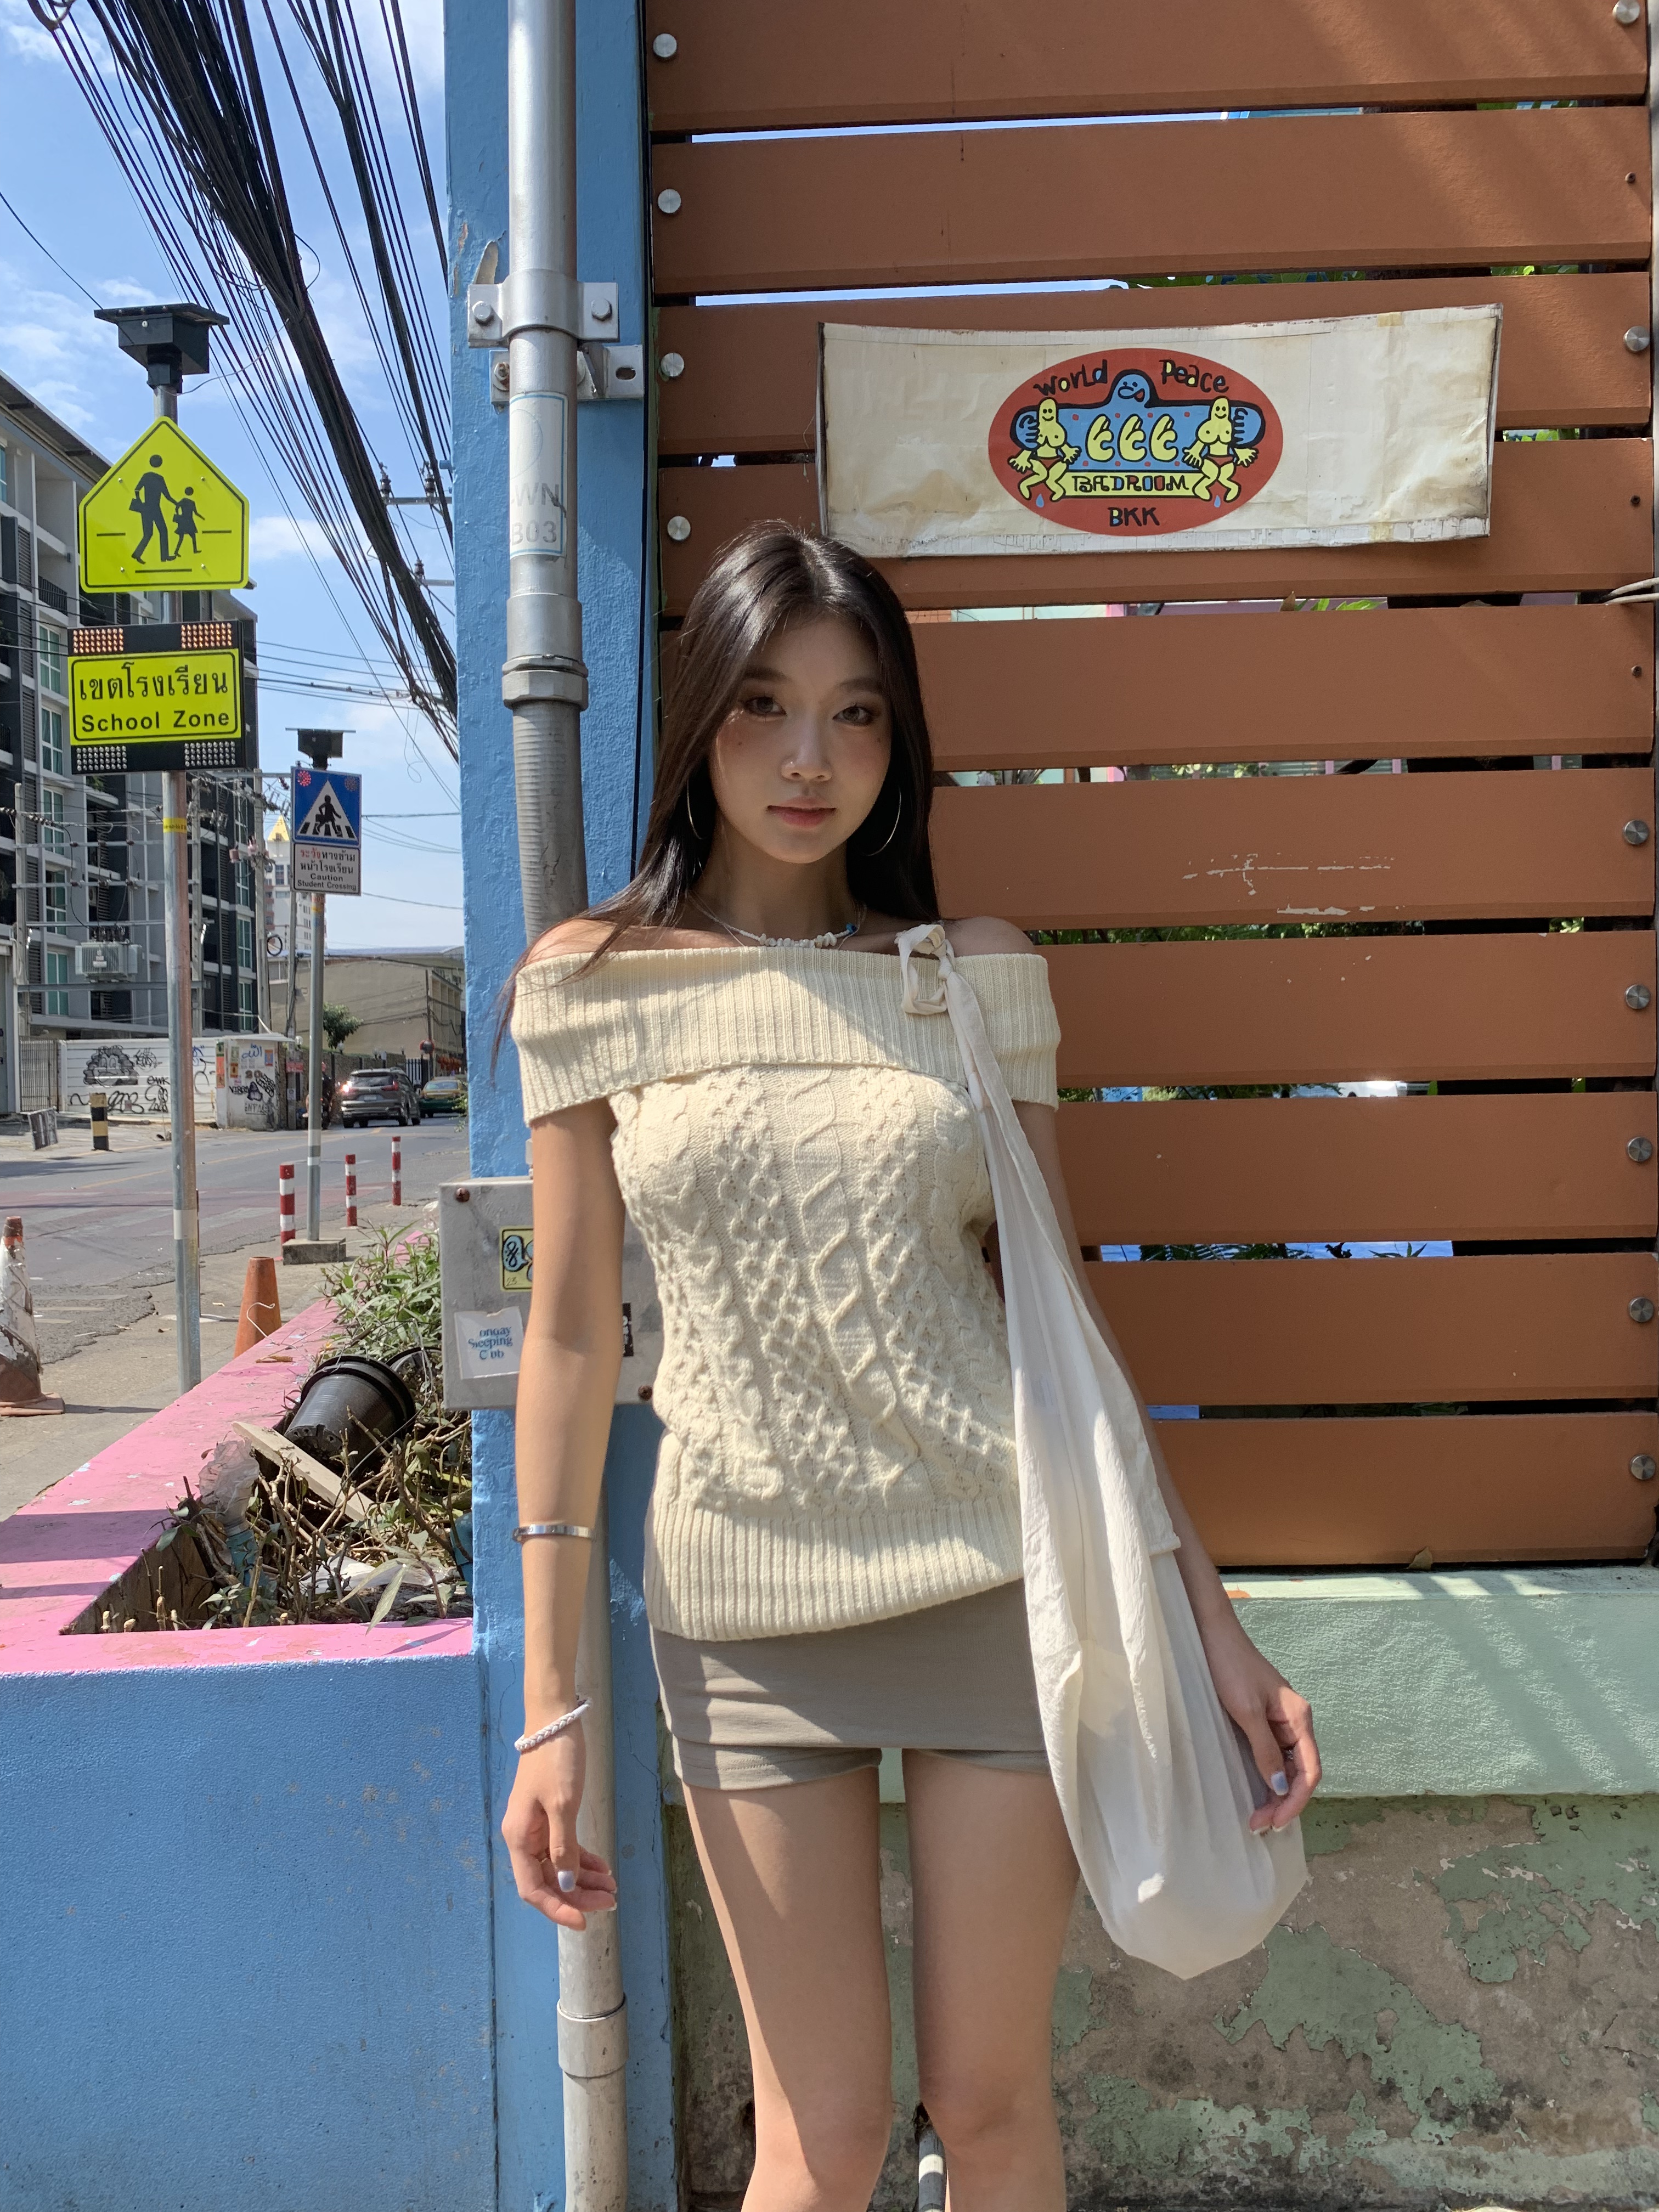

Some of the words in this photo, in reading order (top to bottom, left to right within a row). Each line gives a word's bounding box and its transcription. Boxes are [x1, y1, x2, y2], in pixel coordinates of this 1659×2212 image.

[1159, 359, 1229, 393] Peace
[1107, 506, 1160, 527] BKK
[80, 661, 228, 701] เขตโรงเรียน
[82, 712, 160, 732] School
[173, 710, 229, 728] Zone
[300, 860, 354, 874] หน้าโรงเรียน
[297, 879, 324, 888] Student
[327, 882, 357, 891] Crossing
[311, 873, 343, 882] Caution
[479, 1349, 505, 1360] Cub
